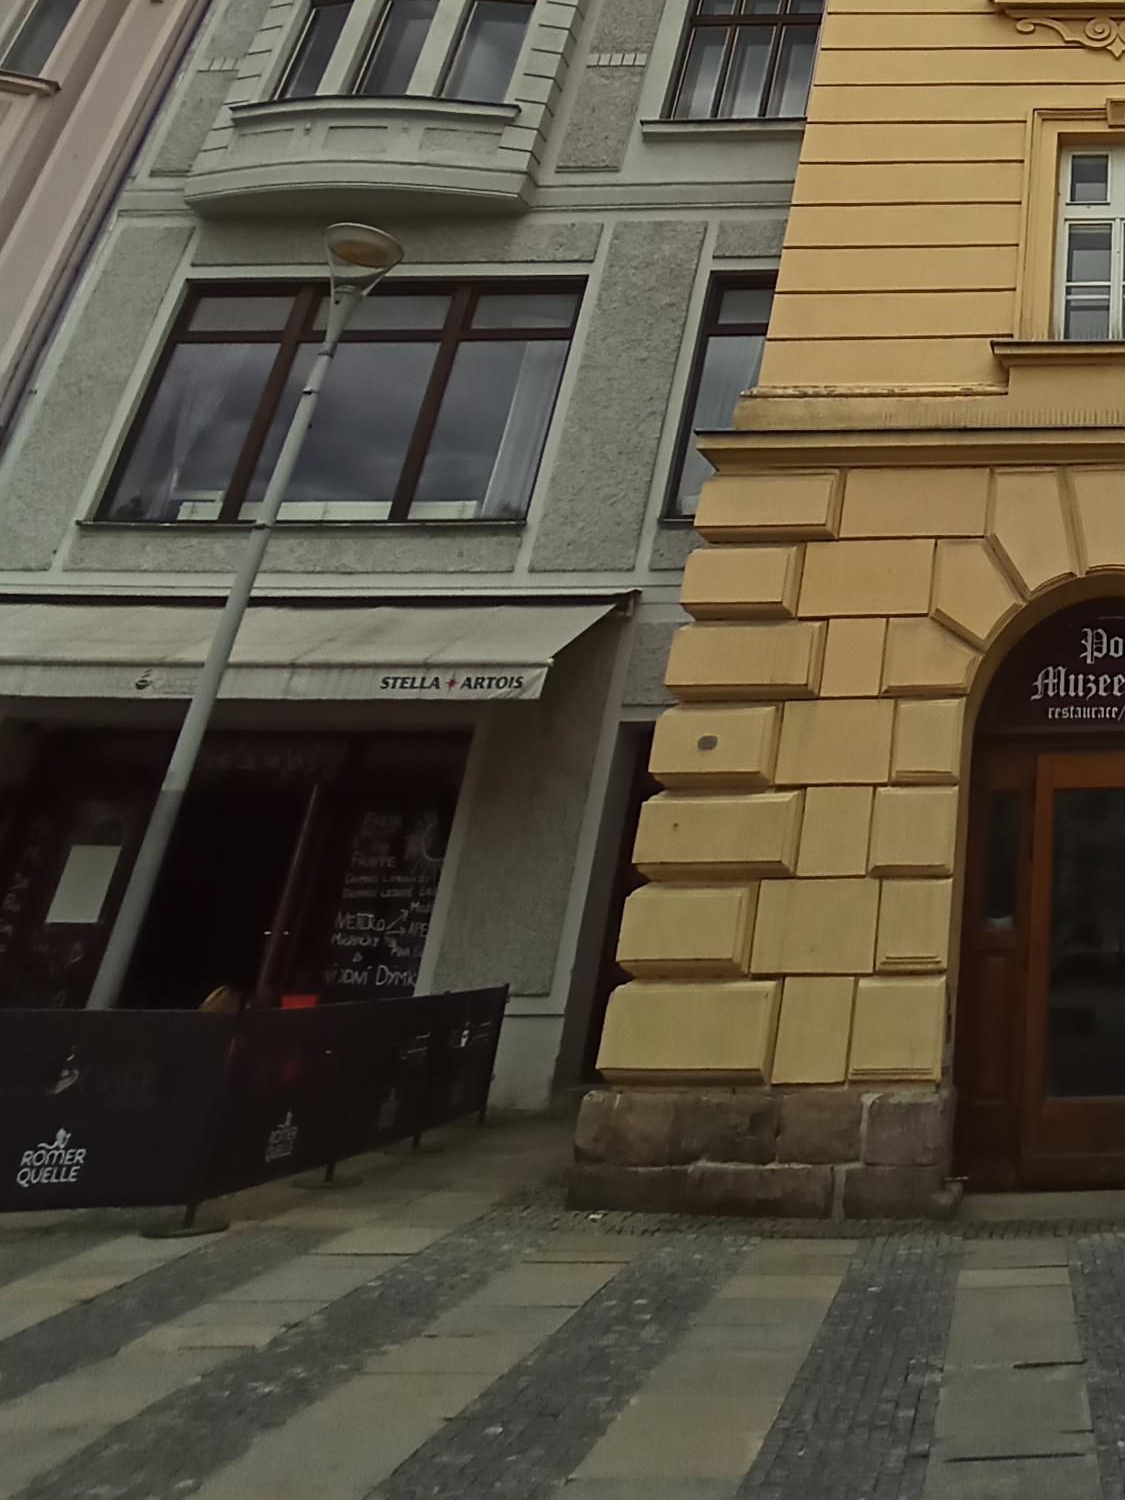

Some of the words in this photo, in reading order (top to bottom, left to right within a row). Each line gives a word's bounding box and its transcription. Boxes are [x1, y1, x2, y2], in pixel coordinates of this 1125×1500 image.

[380, 676, 441, 690] STELLA
[460, 676, 524, 689] ARTOIS
[16, 1165, 81, 1187] QUELLE
